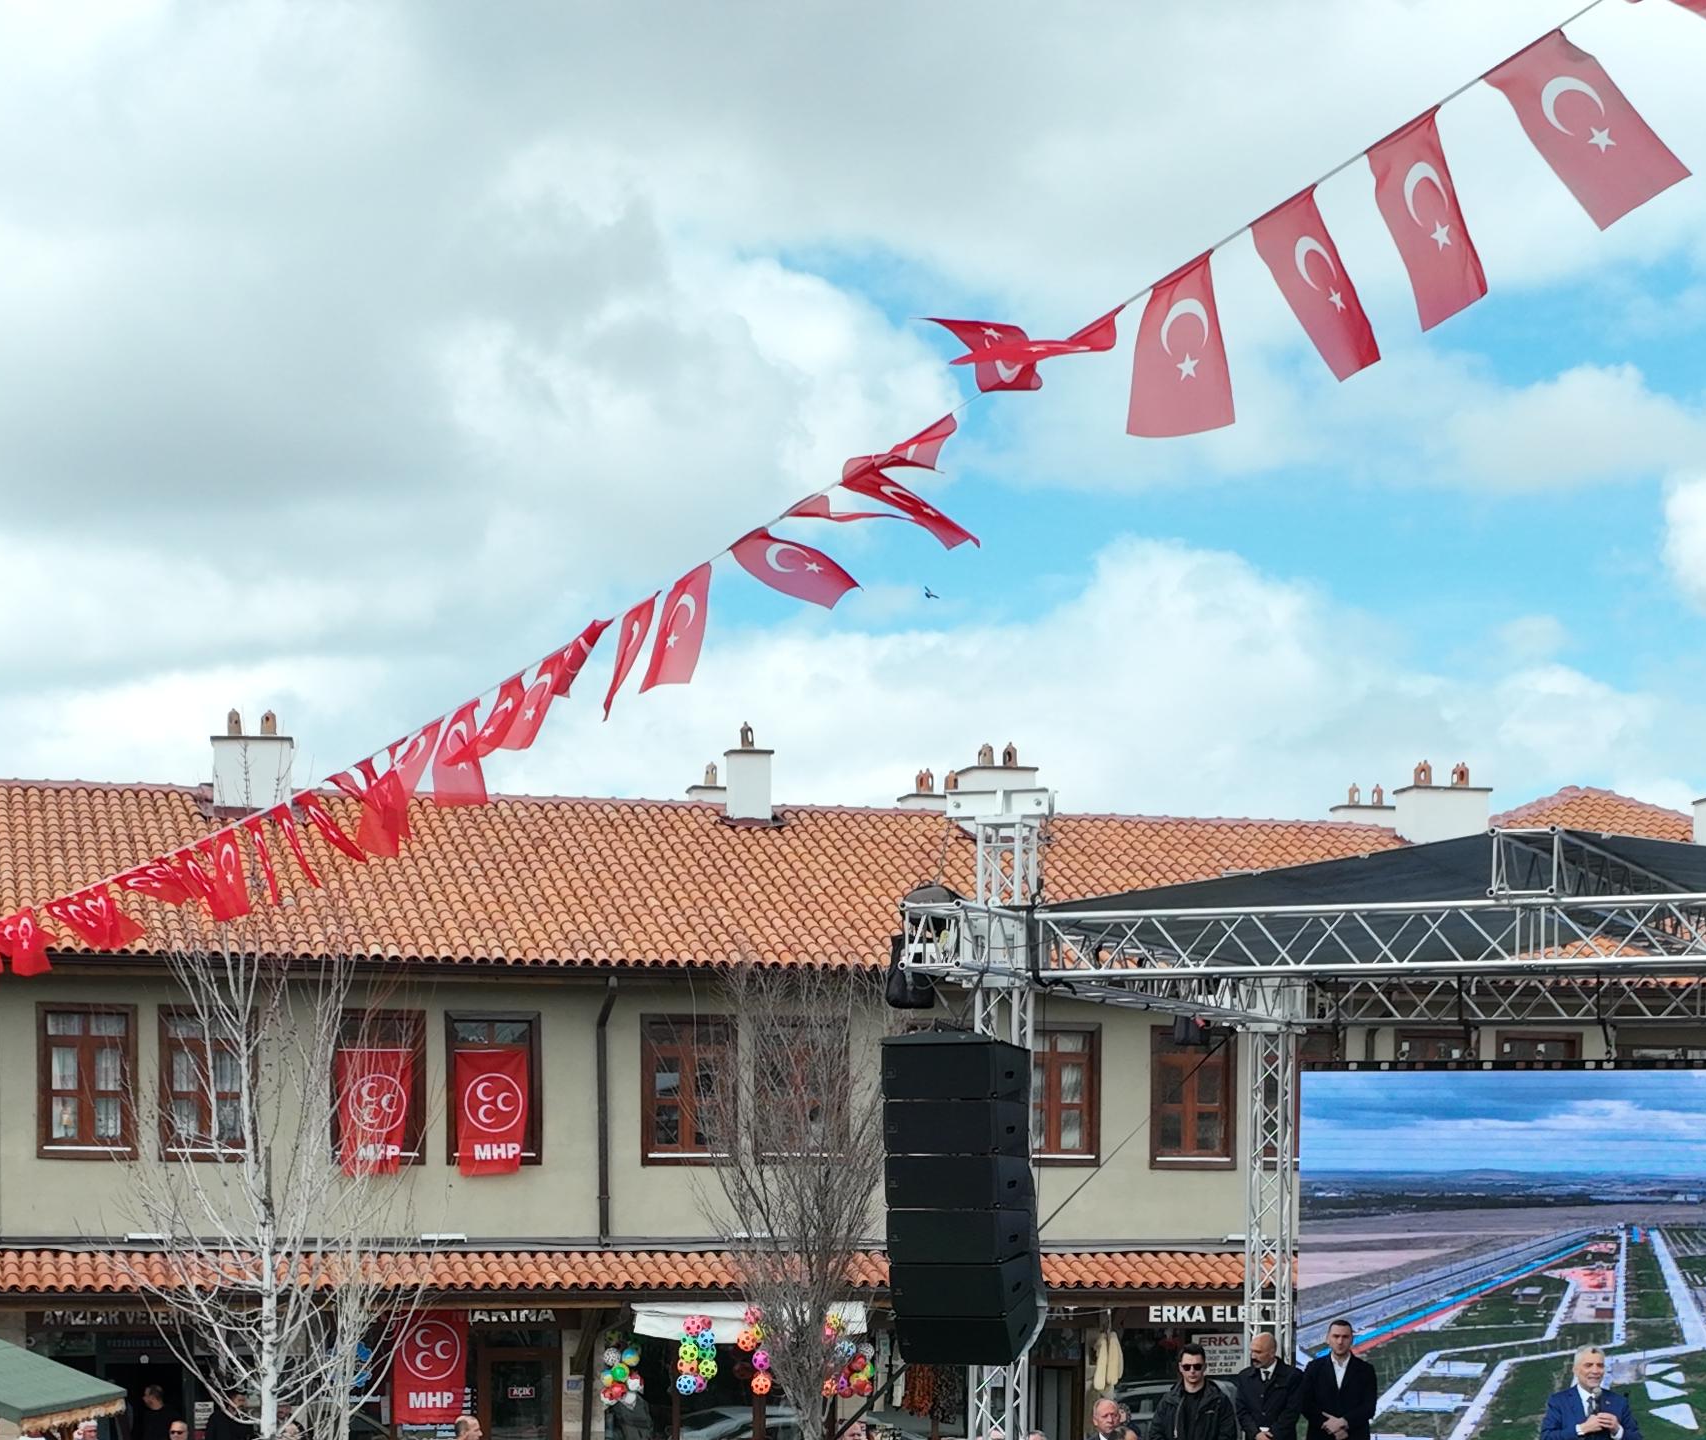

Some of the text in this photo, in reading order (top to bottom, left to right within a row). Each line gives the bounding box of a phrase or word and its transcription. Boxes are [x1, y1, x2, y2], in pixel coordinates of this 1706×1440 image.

[473, 1142, 521, 1161] MHP
[1148, 1305, 1207, 1323] ERKA
[1198, 1335, 1240, 1347] ERKA
[408, 1391, 454, 1409] MHP
